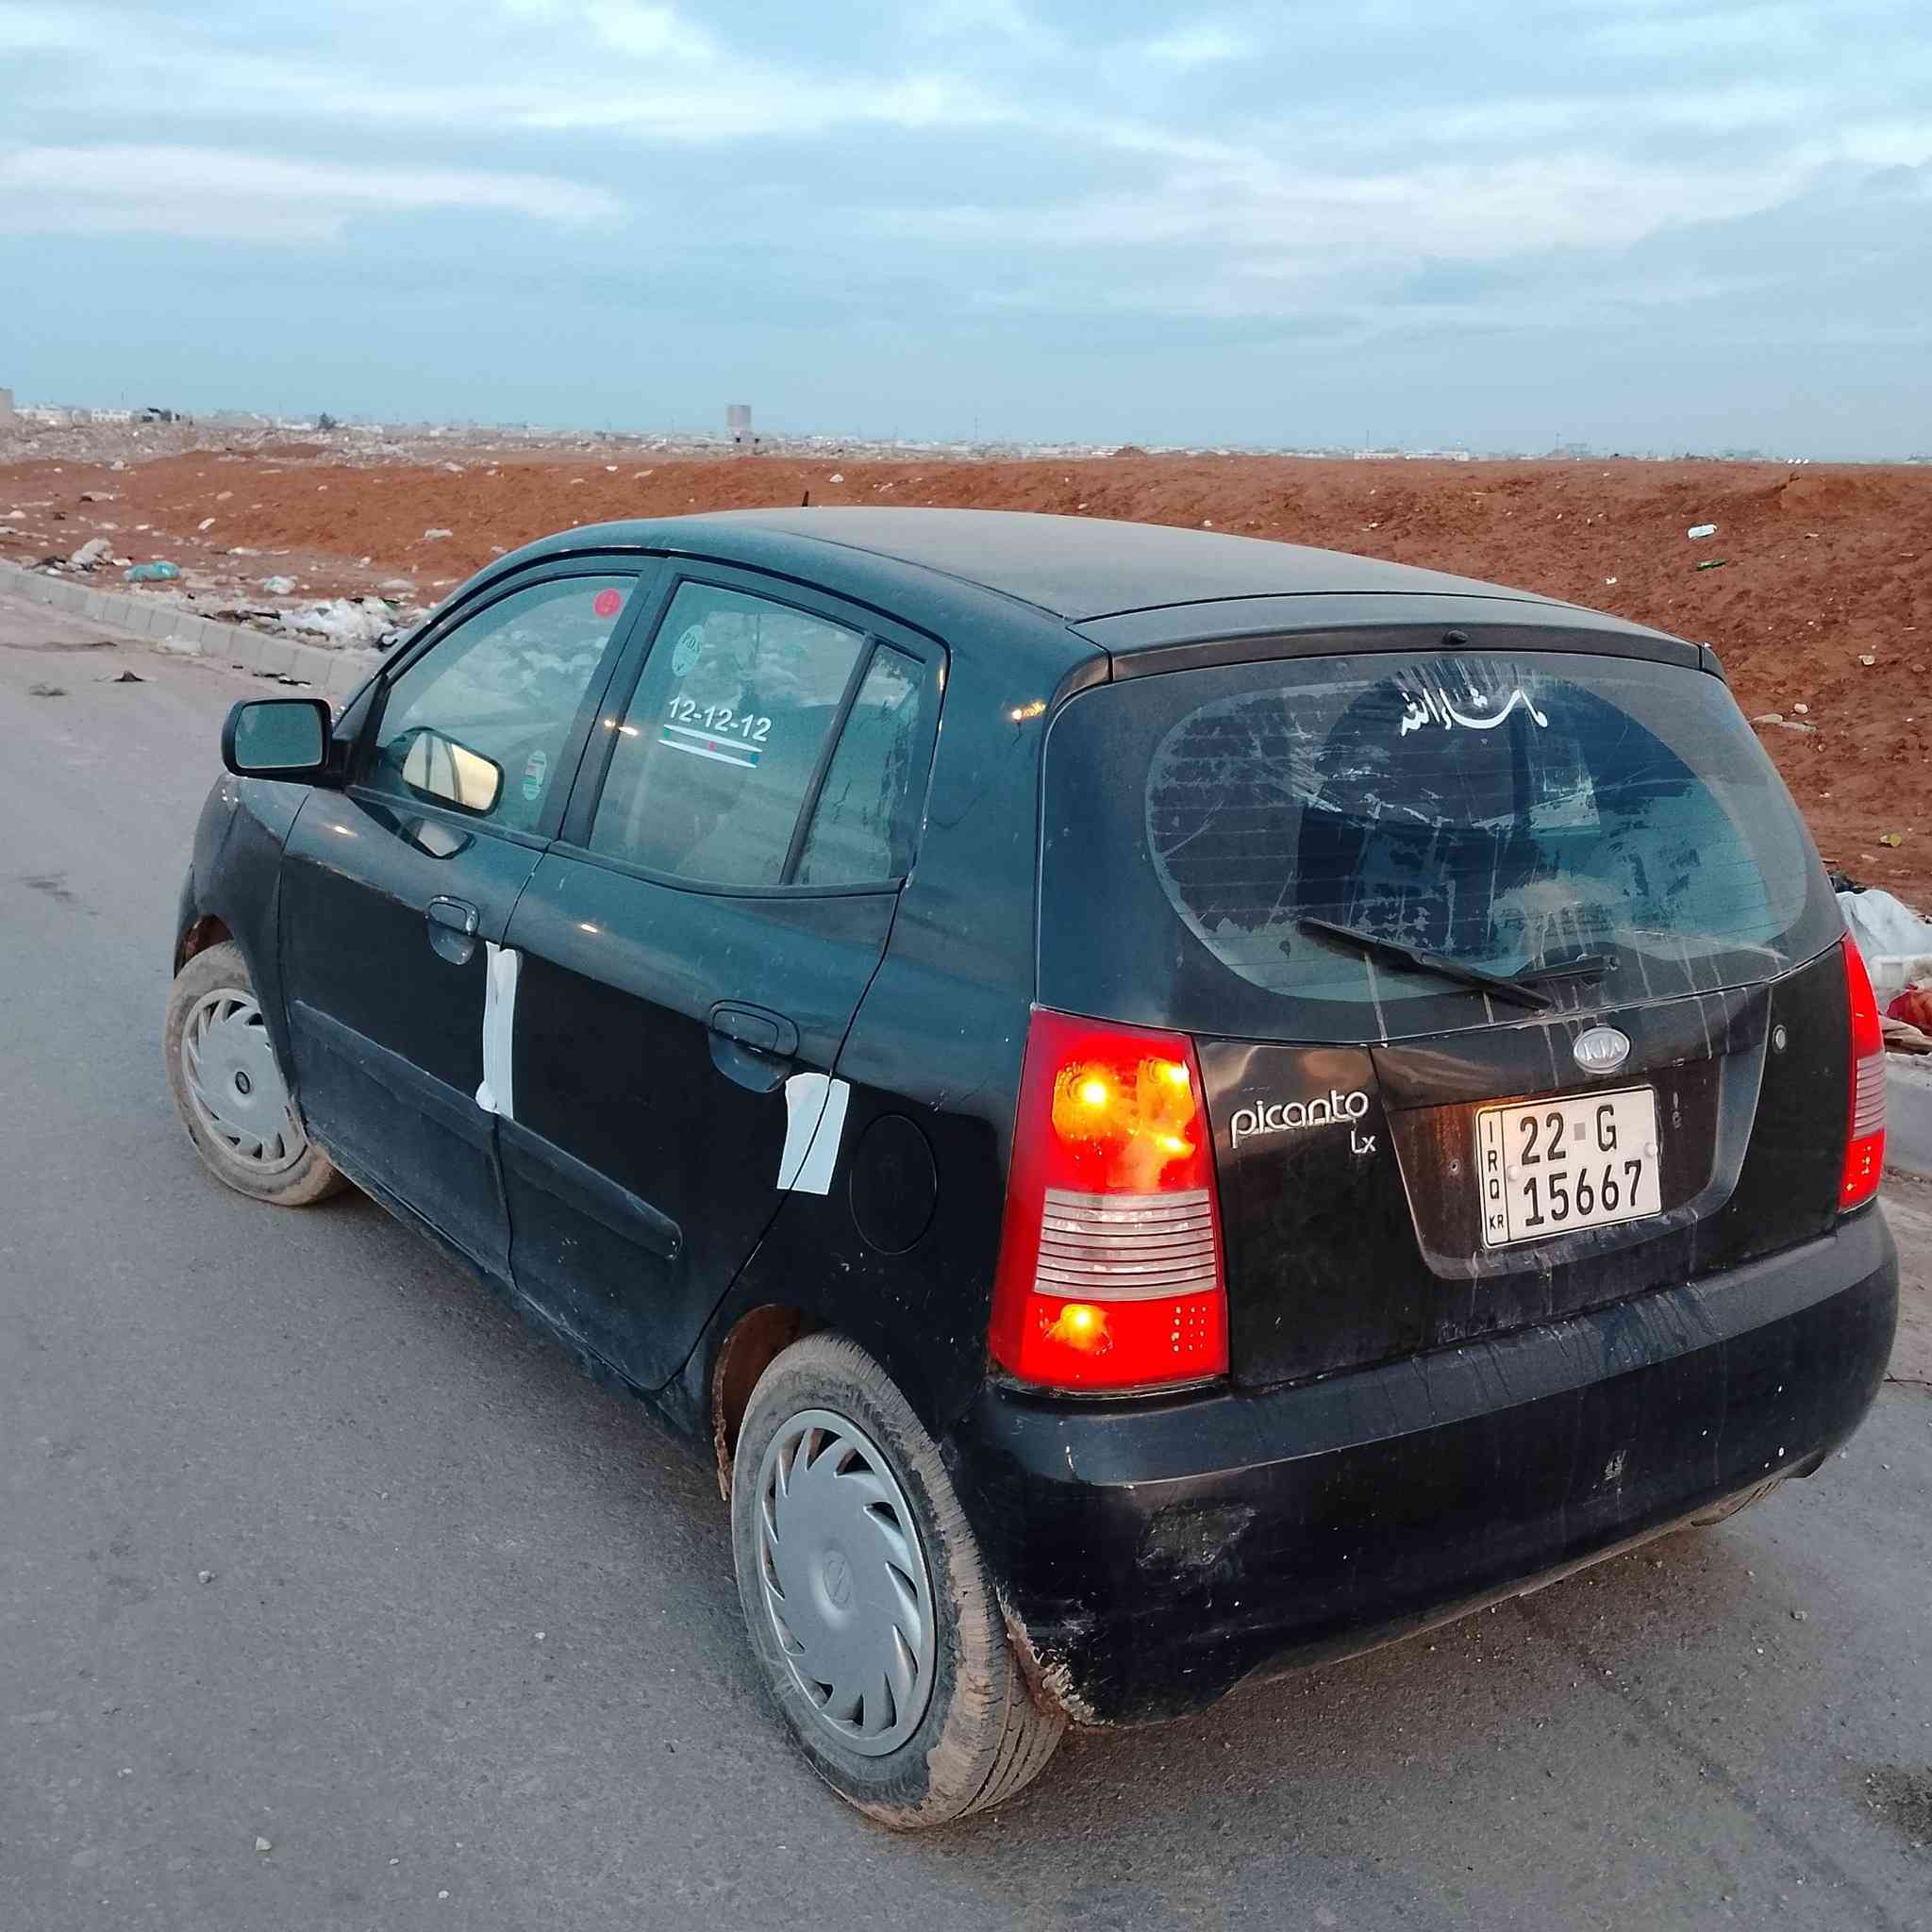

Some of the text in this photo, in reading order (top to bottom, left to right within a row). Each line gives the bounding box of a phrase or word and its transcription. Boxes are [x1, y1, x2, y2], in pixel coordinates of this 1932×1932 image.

[669, 696, 772, 741] 12-12-12
[1231, 1090, 1369, 1149] picanto
[1519, 1105, 1617, 1165] 22 G
[1489, 1213, 1505, 1231] KR
[1524, 1159, 1642, 1226] 15667
